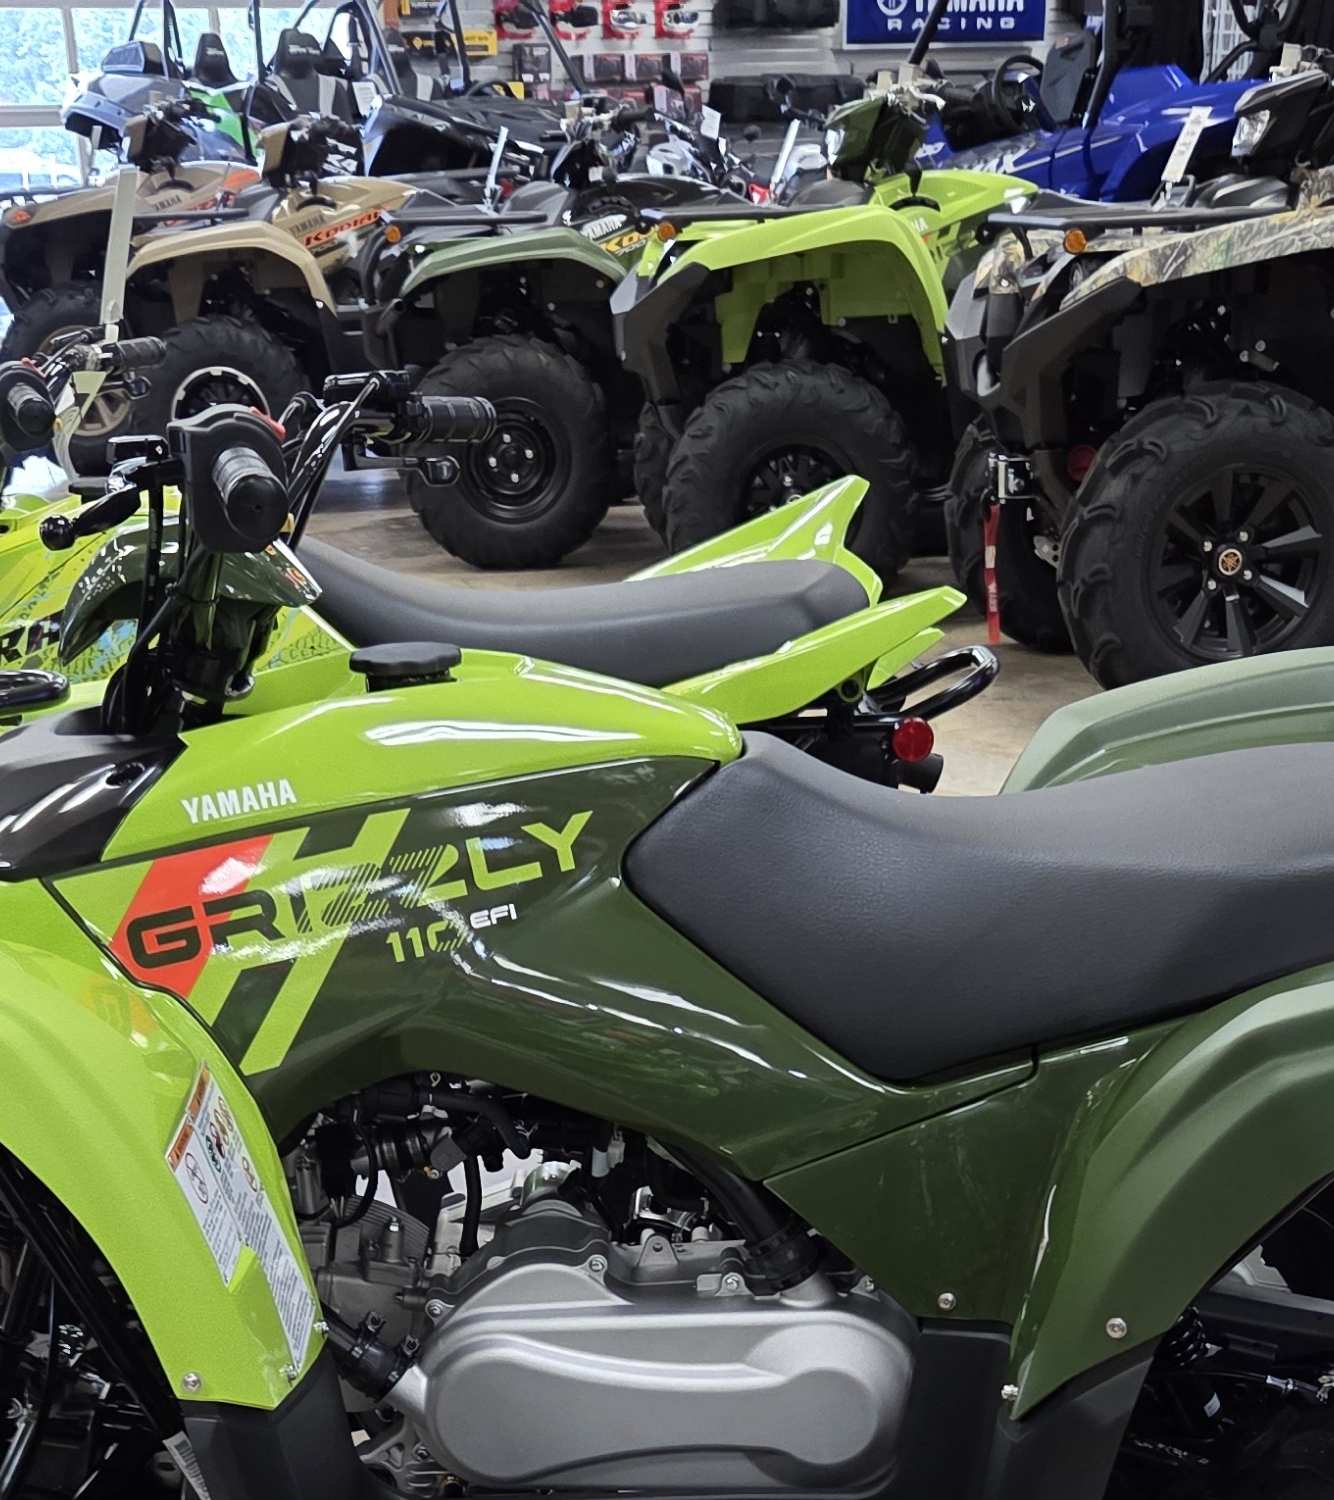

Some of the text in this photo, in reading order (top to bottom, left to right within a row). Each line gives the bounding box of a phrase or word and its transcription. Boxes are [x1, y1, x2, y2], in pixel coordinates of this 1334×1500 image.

[180, 778, 298, 825] YAMAHA
[126, 809, 595, 971] GRIZZLY
[469, 902, 518, 931] EFI
